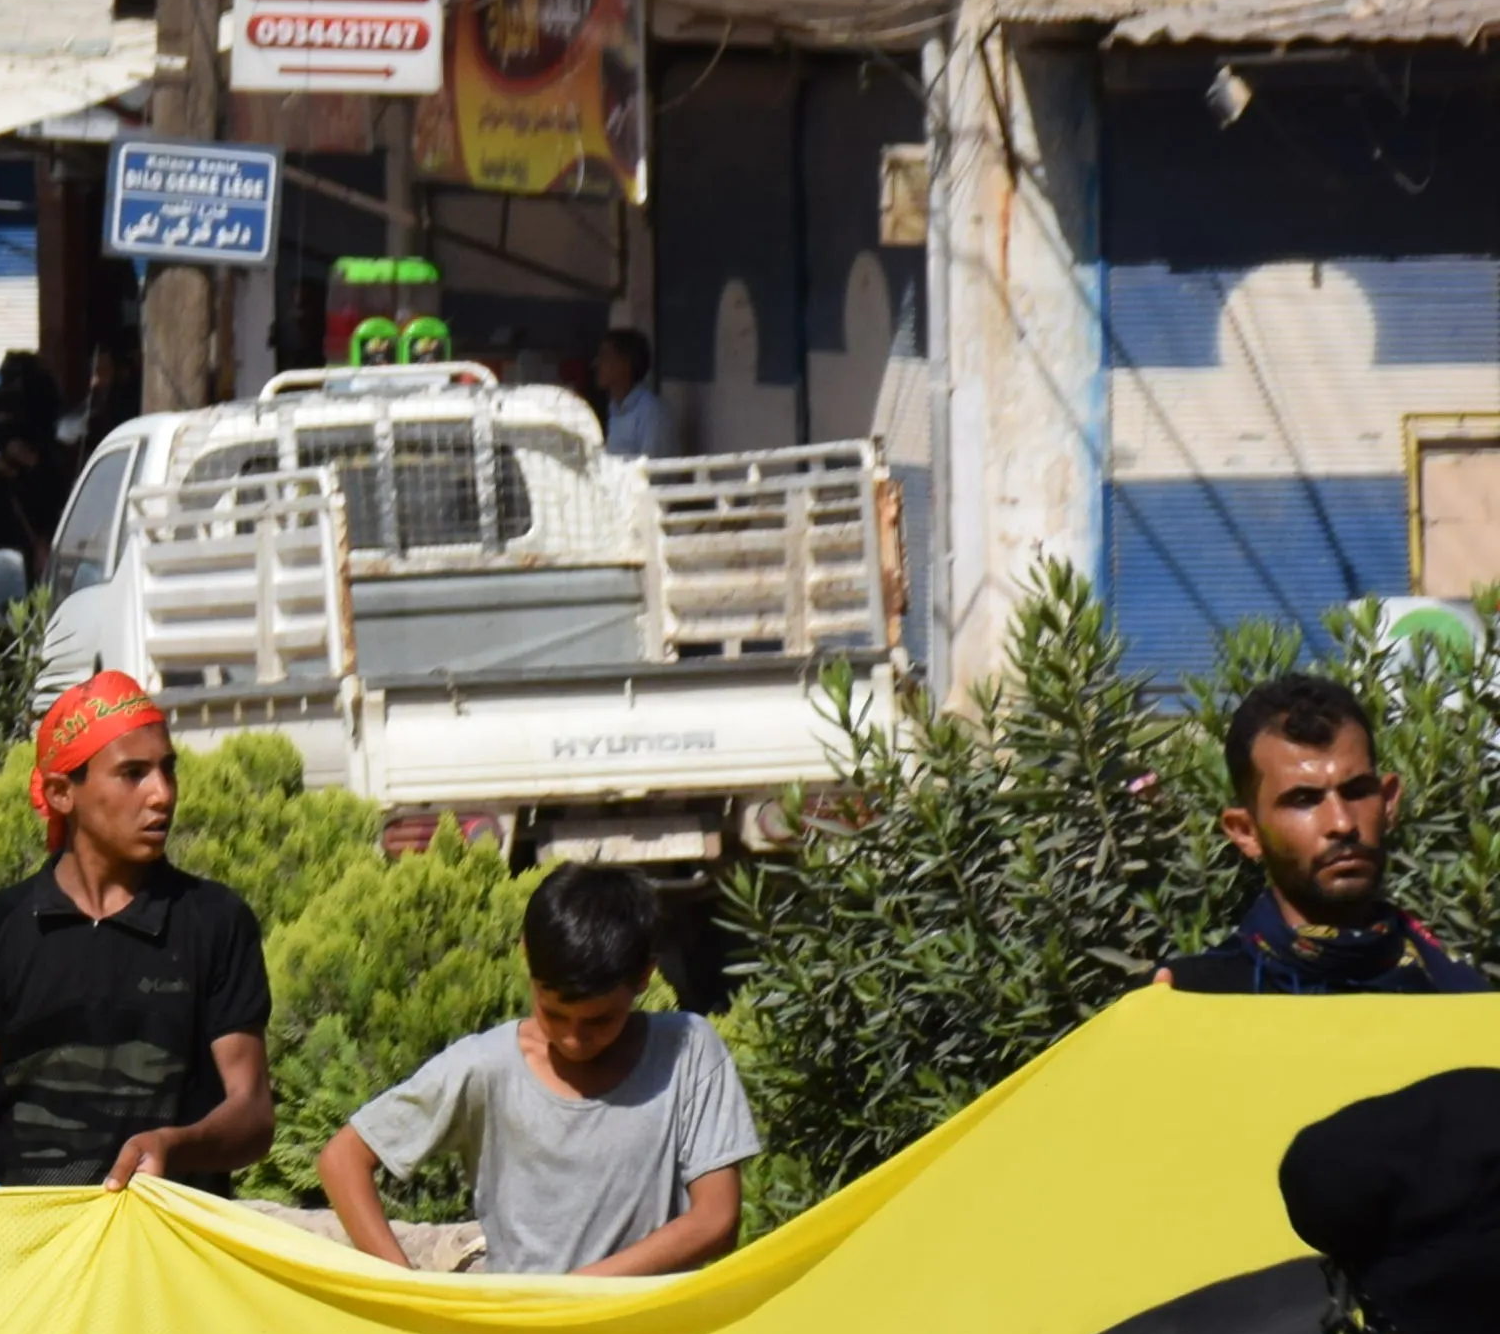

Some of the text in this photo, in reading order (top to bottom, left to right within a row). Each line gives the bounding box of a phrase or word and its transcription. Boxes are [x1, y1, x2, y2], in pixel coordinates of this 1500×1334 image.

[125, 168, 163, 191] DILO
[215, 221, 252, 249] دلو
[553, 729, 717, 759] HYUNDAI
